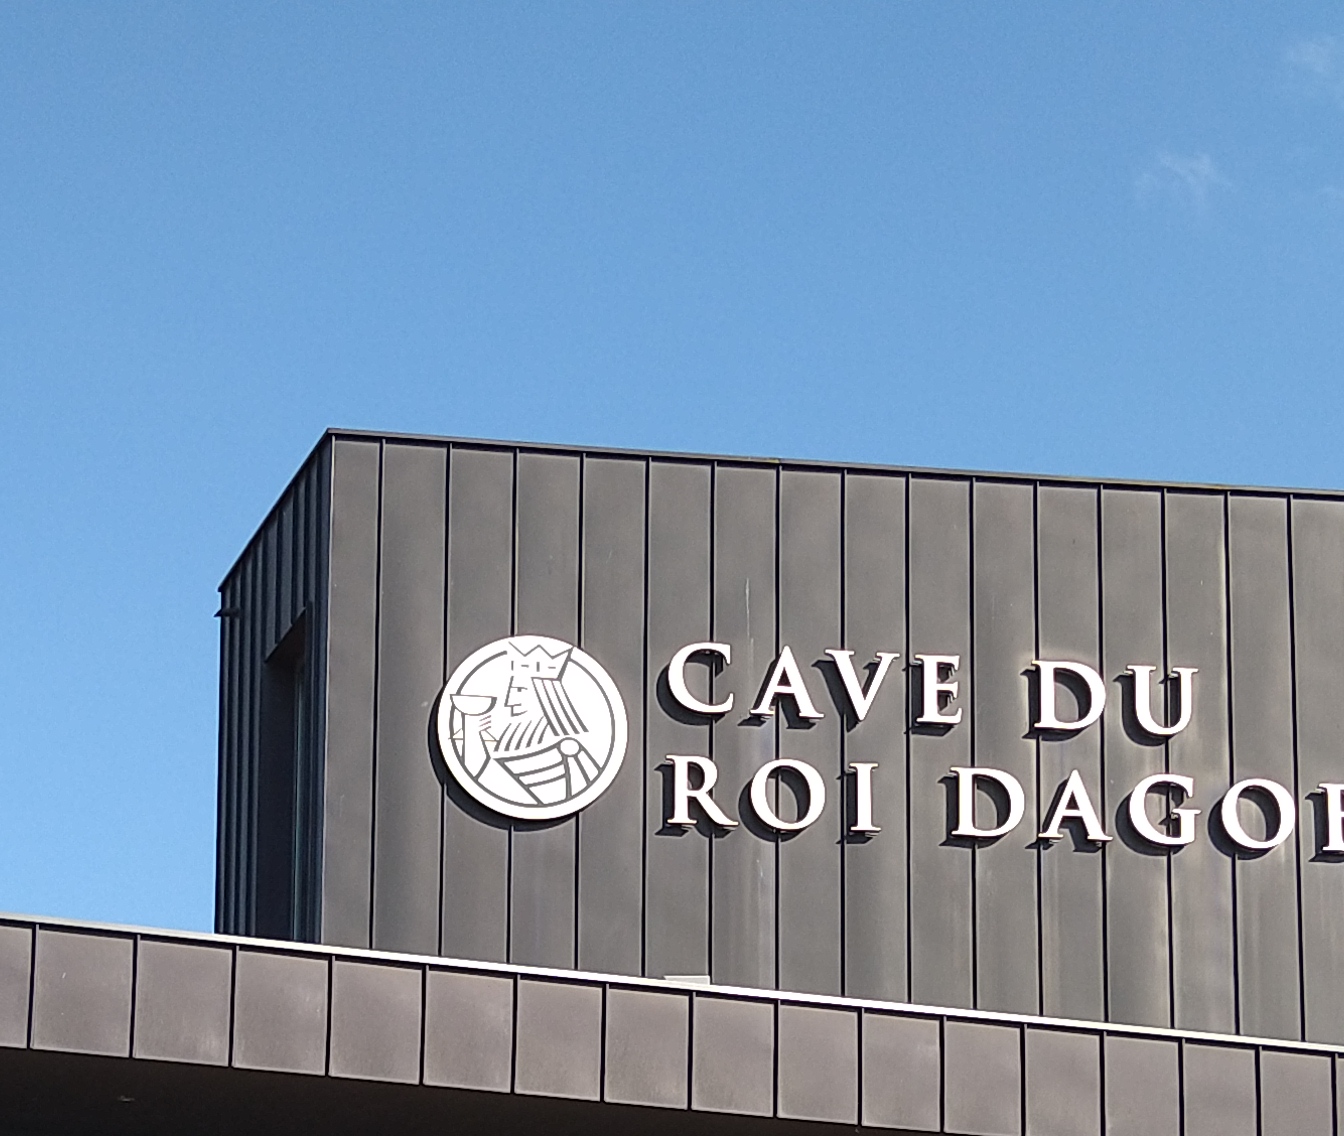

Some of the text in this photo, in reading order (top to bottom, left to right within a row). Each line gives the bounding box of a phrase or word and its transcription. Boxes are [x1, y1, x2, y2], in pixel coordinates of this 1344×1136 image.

[667, 641, 1200, 736] CAVE DU
[665, 753, 882, 833] ROI
